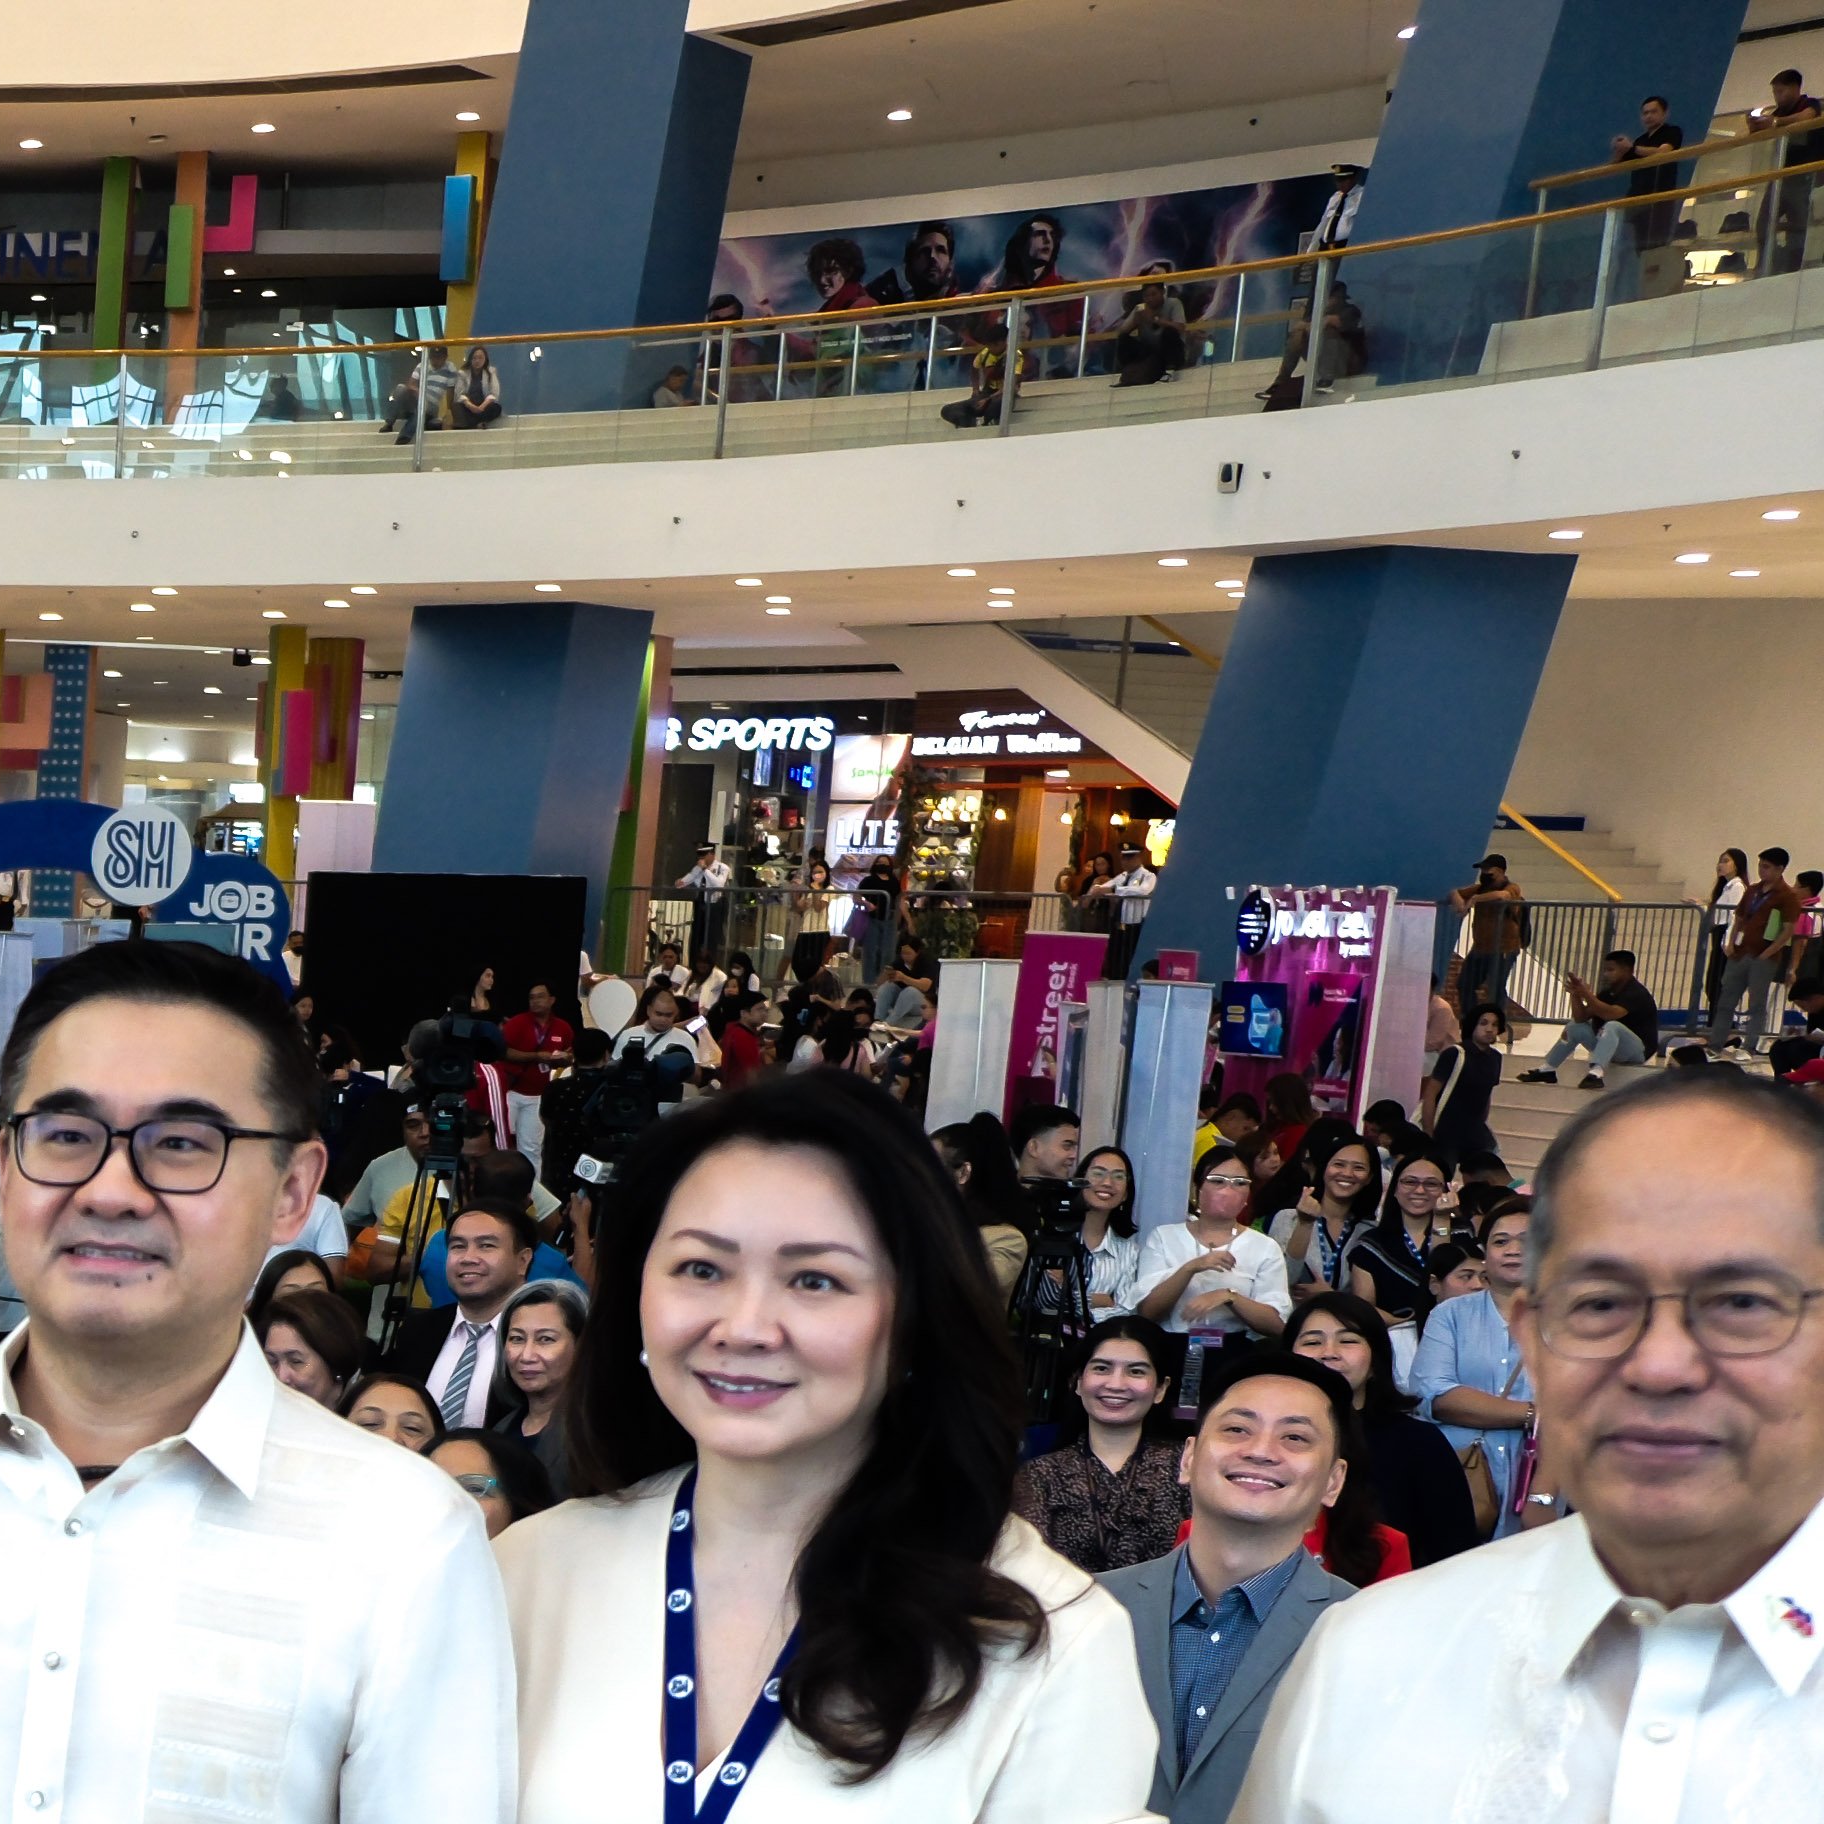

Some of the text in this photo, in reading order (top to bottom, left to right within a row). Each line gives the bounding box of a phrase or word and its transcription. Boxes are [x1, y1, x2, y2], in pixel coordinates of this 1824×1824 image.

[688, 717, 834, 751] SPORTS
[835, 819, 899, 847] LITE
[104, 820, 176, 889] SM
[189, 881, 275, 921] JOB
